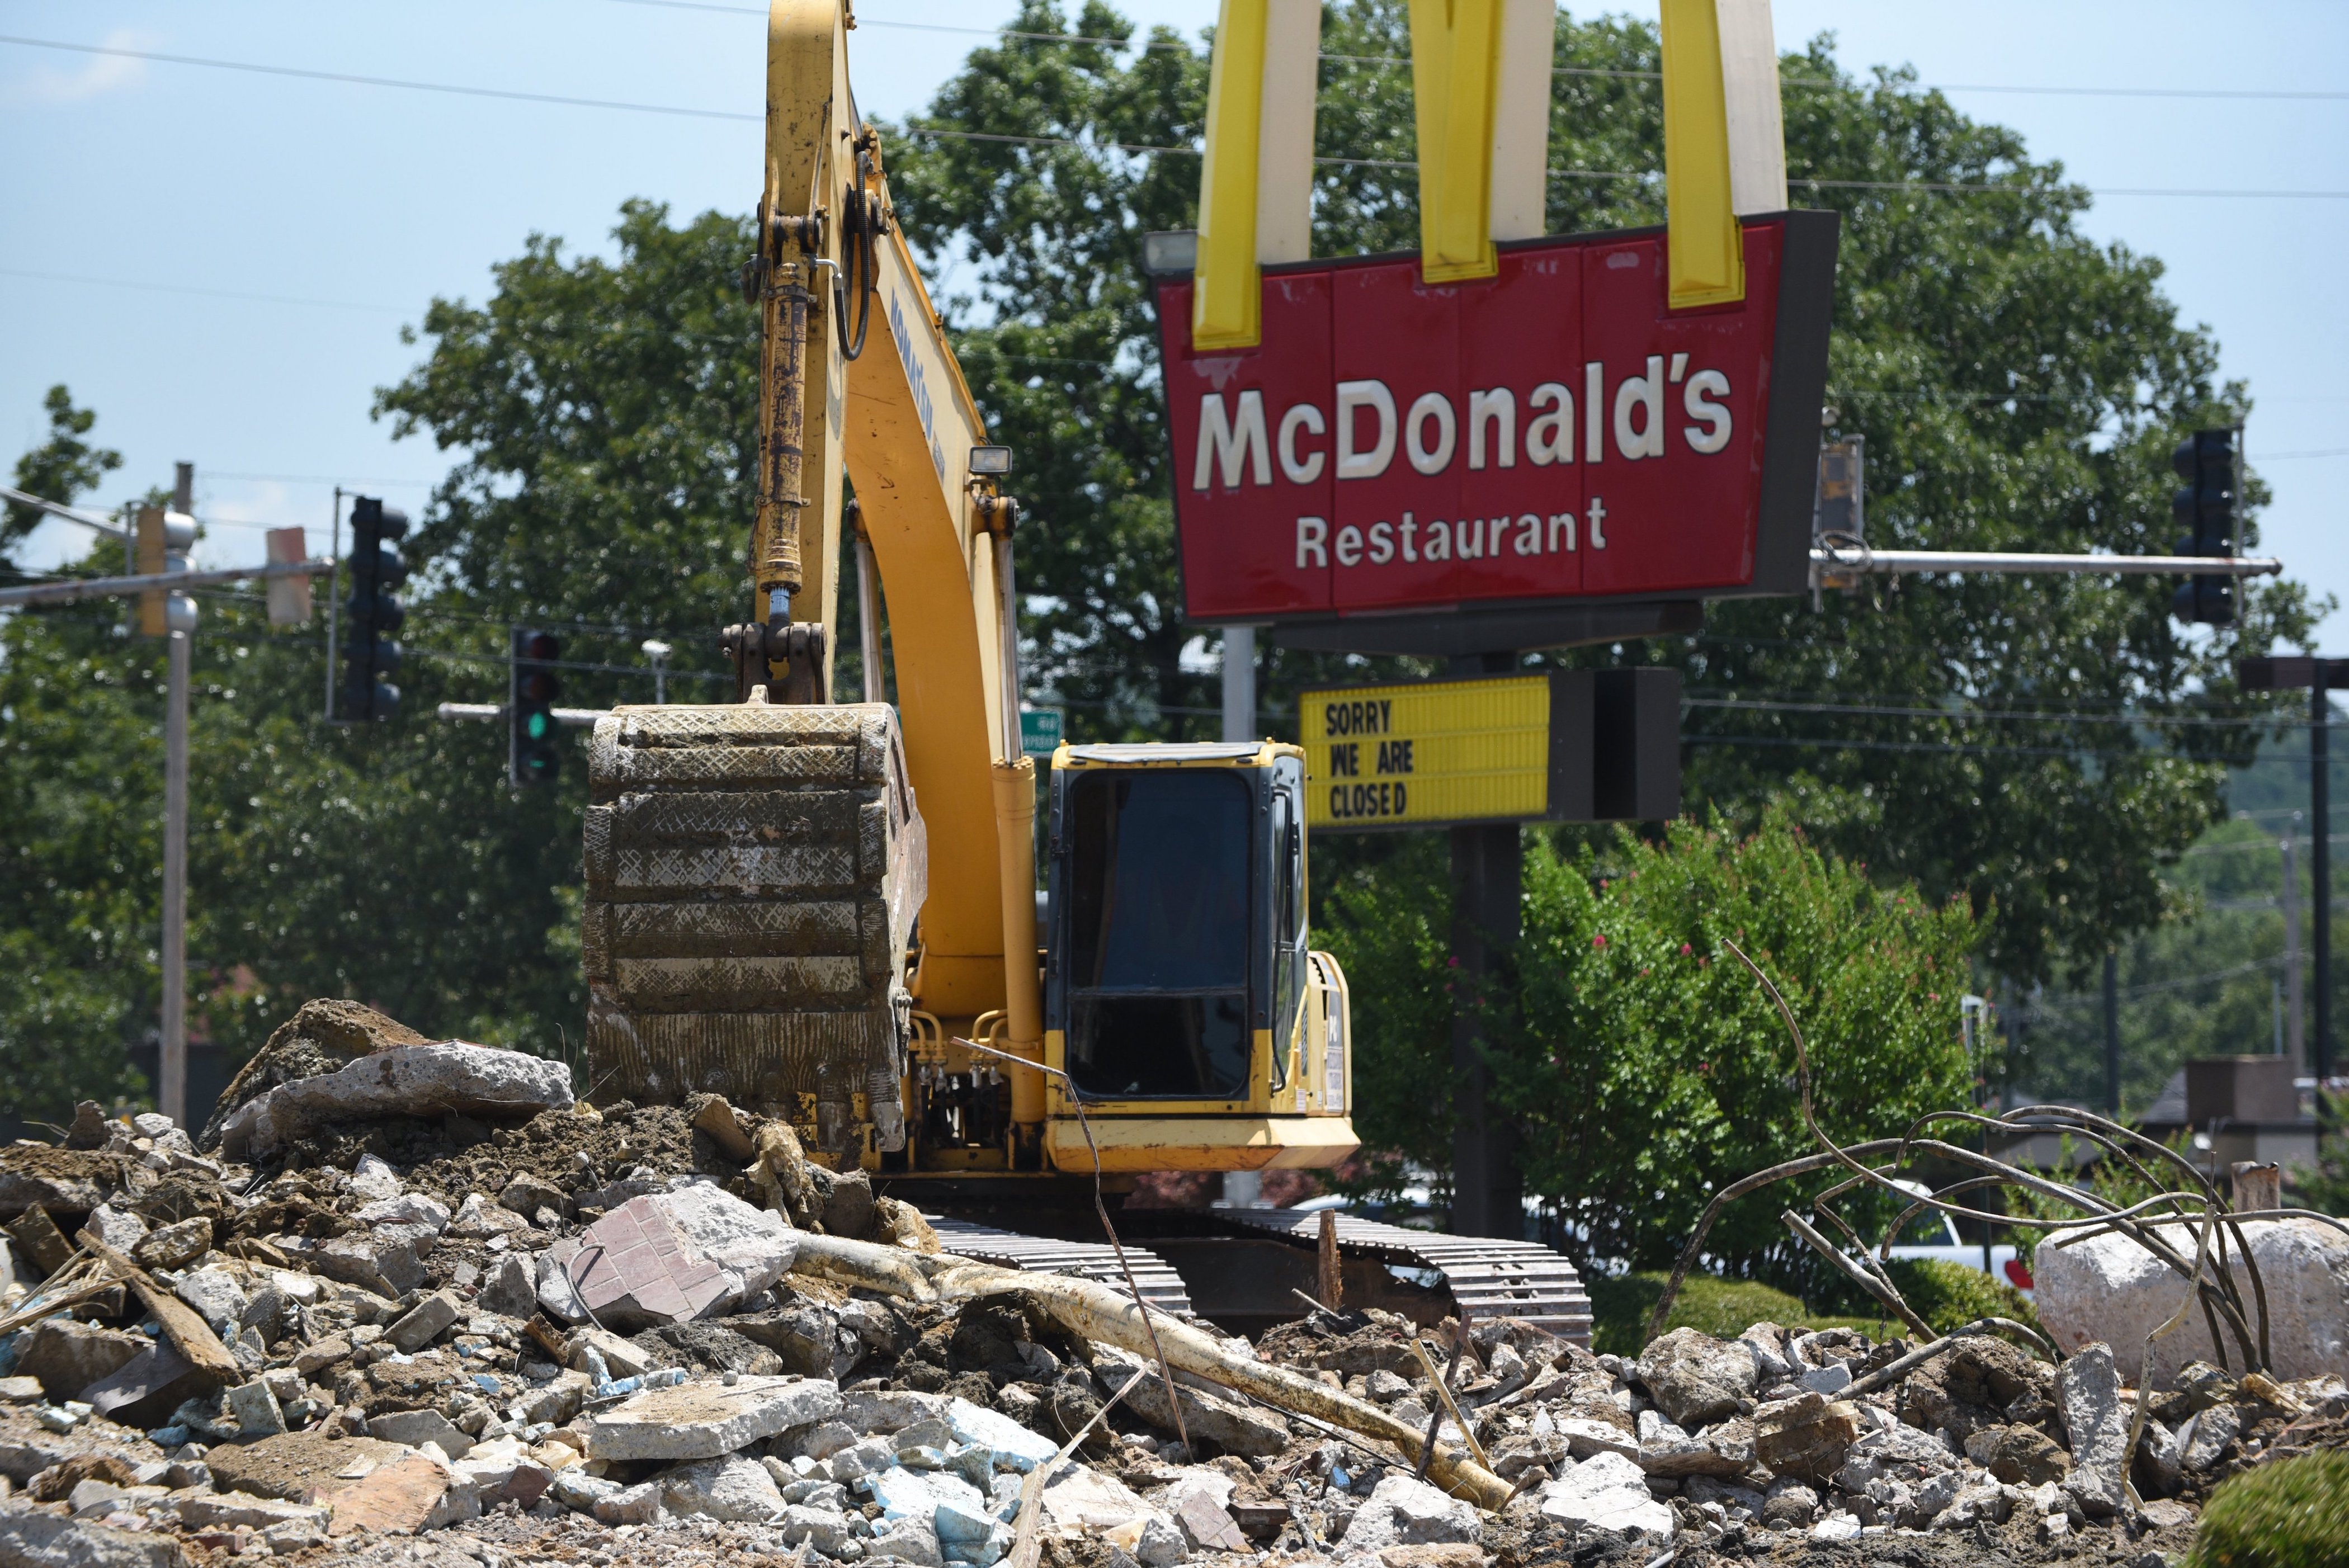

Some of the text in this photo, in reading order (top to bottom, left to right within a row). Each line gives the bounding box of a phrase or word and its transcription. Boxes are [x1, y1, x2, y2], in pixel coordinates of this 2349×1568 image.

[890, 286, 933, 440] KOMATSU
[1192, 352, 1733, 490] McDonald's
[1296, 497, 1607, 568] Restaurant
[1326, 699, 1392, 736] SORRY
[1330, 739, 1414, 777] WE ARE
[1329, 781, 1407, 819] CLOSED
